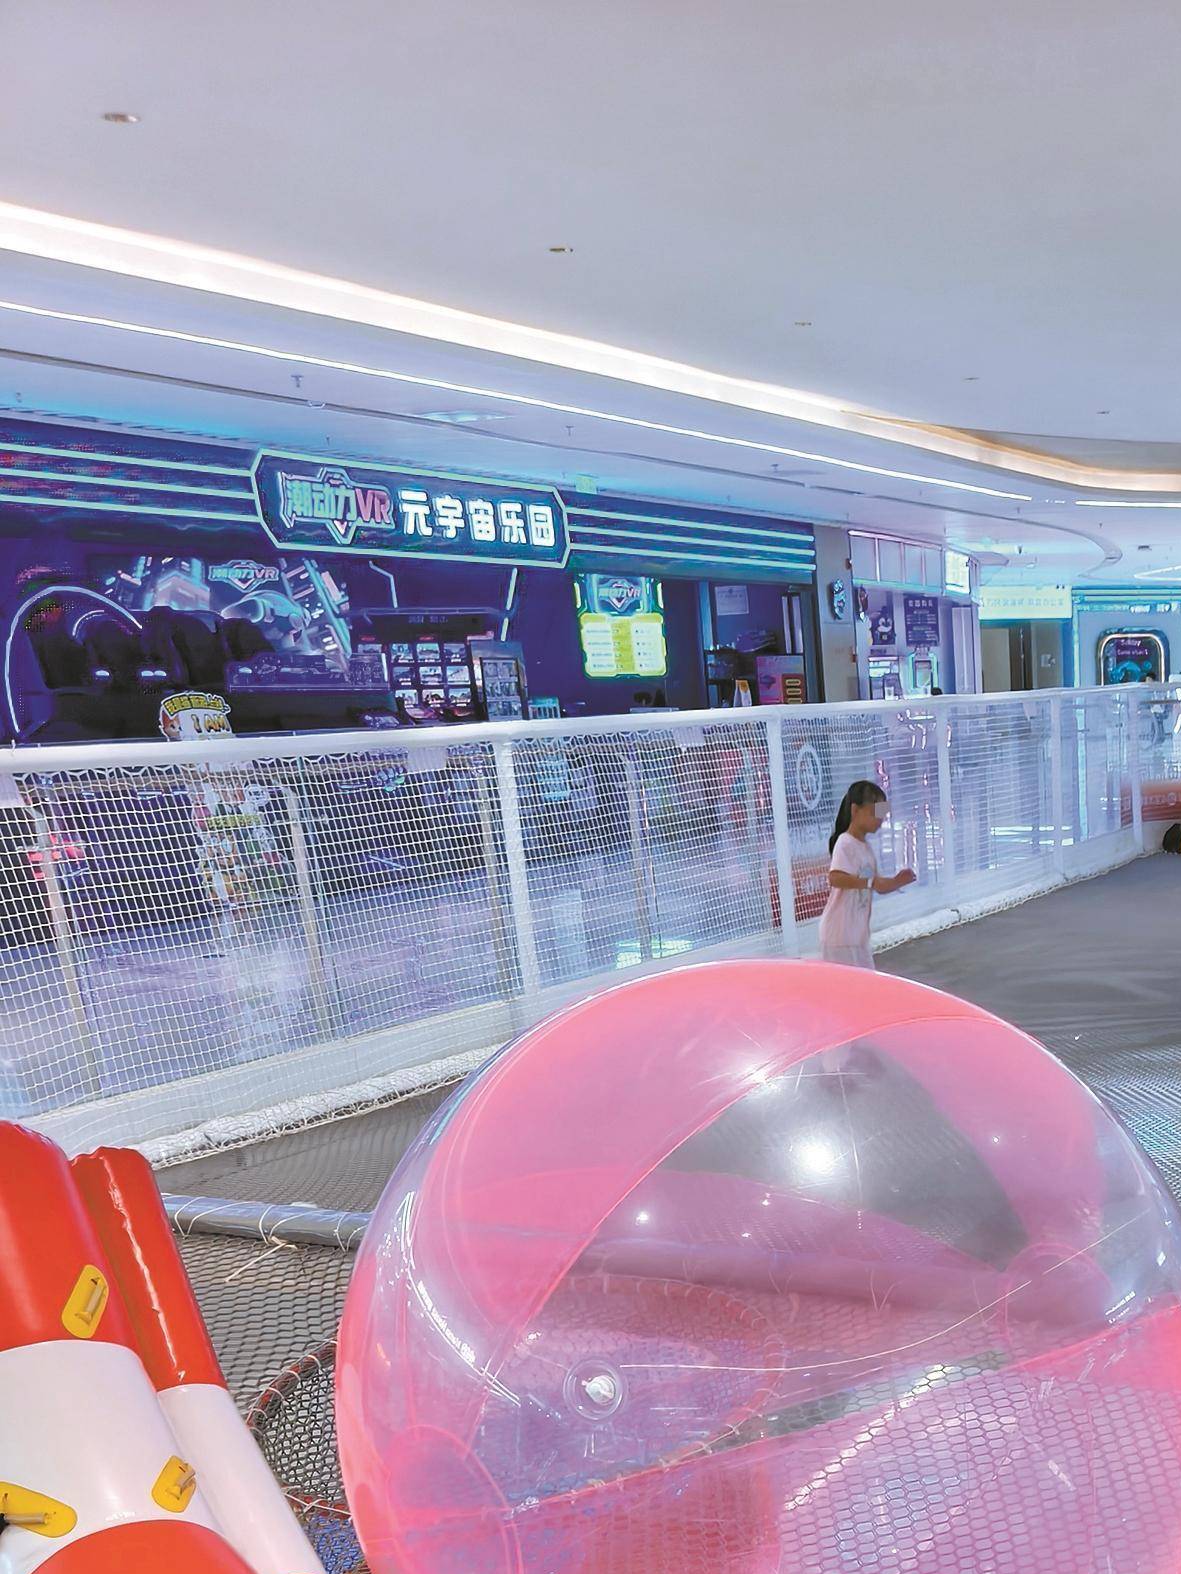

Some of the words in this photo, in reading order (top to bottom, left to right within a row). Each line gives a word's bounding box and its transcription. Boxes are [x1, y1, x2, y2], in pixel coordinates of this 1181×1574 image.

[285, 478, 392, 524] 潮动力VR
[400, 489, 556, 547] 元宇宙乐园
